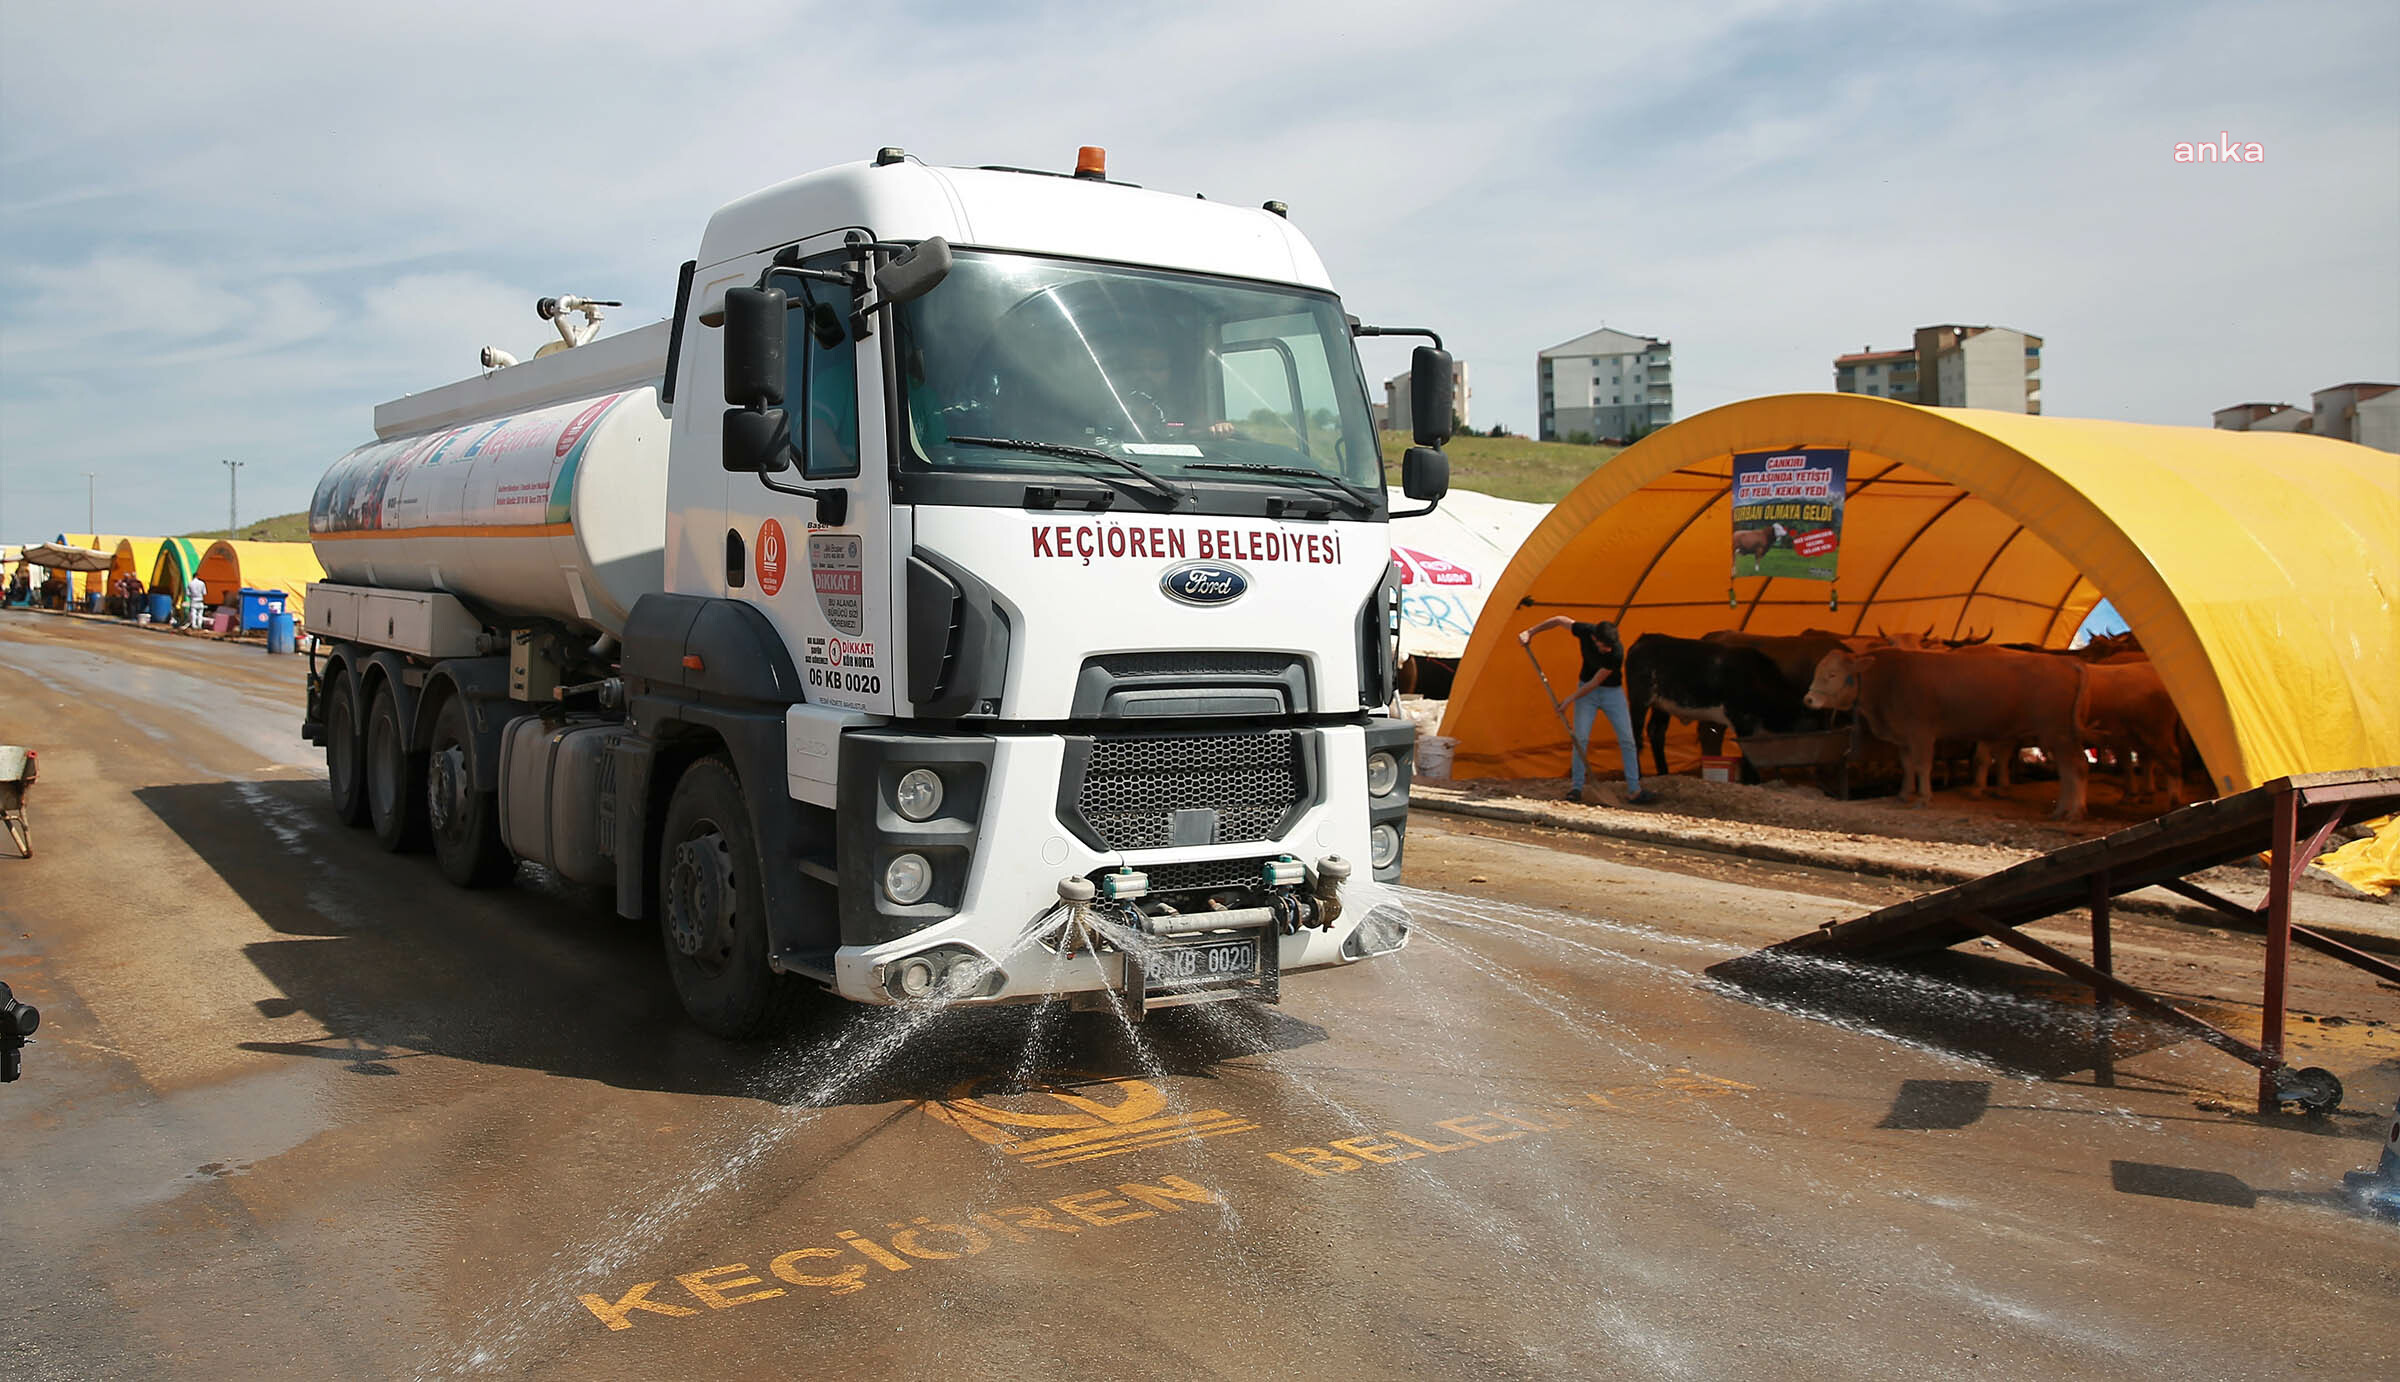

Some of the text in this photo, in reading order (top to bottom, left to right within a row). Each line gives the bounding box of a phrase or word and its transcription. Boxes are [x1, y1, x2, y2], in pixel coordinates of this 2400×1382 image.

[1741, 469, 1830, 484] YAYLASINDA YETİŞTİ
[1740, 487, 1749, 498] OT
[1804, 484, 1828, 497] YEDİ
[1764, 504, 1800, 520] OLMAYA
[1802, 502, 1833, 522] GELDİ
[1031, 520, 1342, 567] KEÇİÖREN BELEDİYESİ
[1184, 569, 1233, 596] Ford
[842, 640, 874, 655] DİKKAT!
[854, 656, 875, 669] NOKTA
[809, 667, 881, 695] 06 KB 0020
[1174, 948, 1196, 977] KB
[1208, 945, 1251, 974] 0020
[577, 1174, 1222, 1332] KEÇİÖREN
